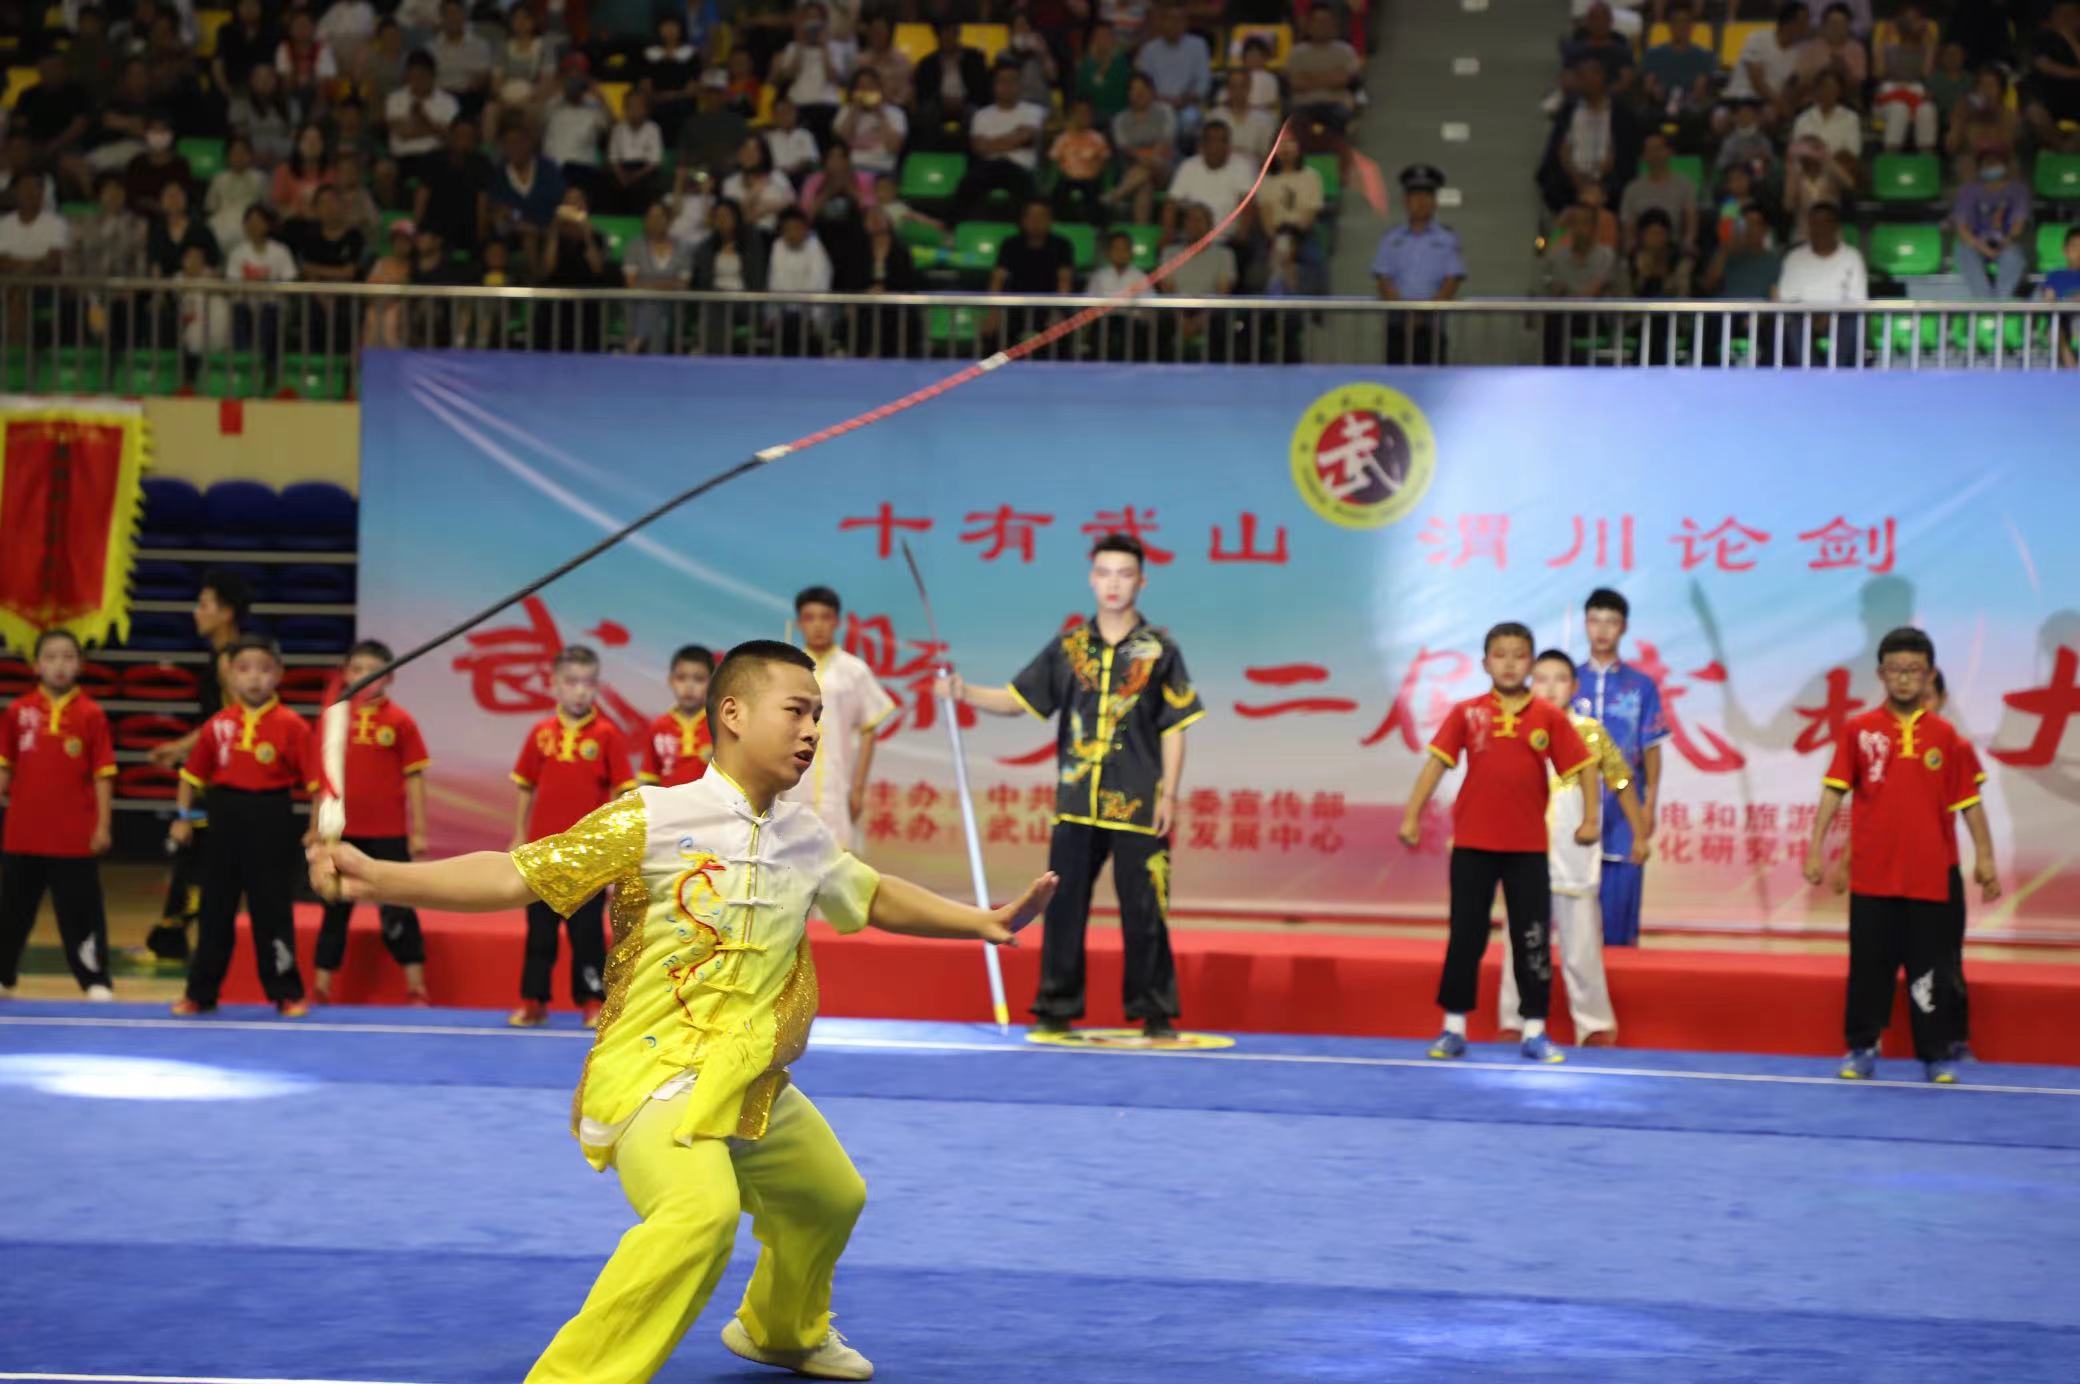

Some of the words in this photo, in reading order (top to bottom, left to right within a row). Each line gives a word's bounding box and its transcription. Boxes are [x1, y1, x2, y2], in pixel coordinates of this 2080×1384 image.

[1317, 412, 1403, 498] 武
[838, 501, 1289, 565] 十有武山
[1417, 513, 1897, 574] 渭川论剑
